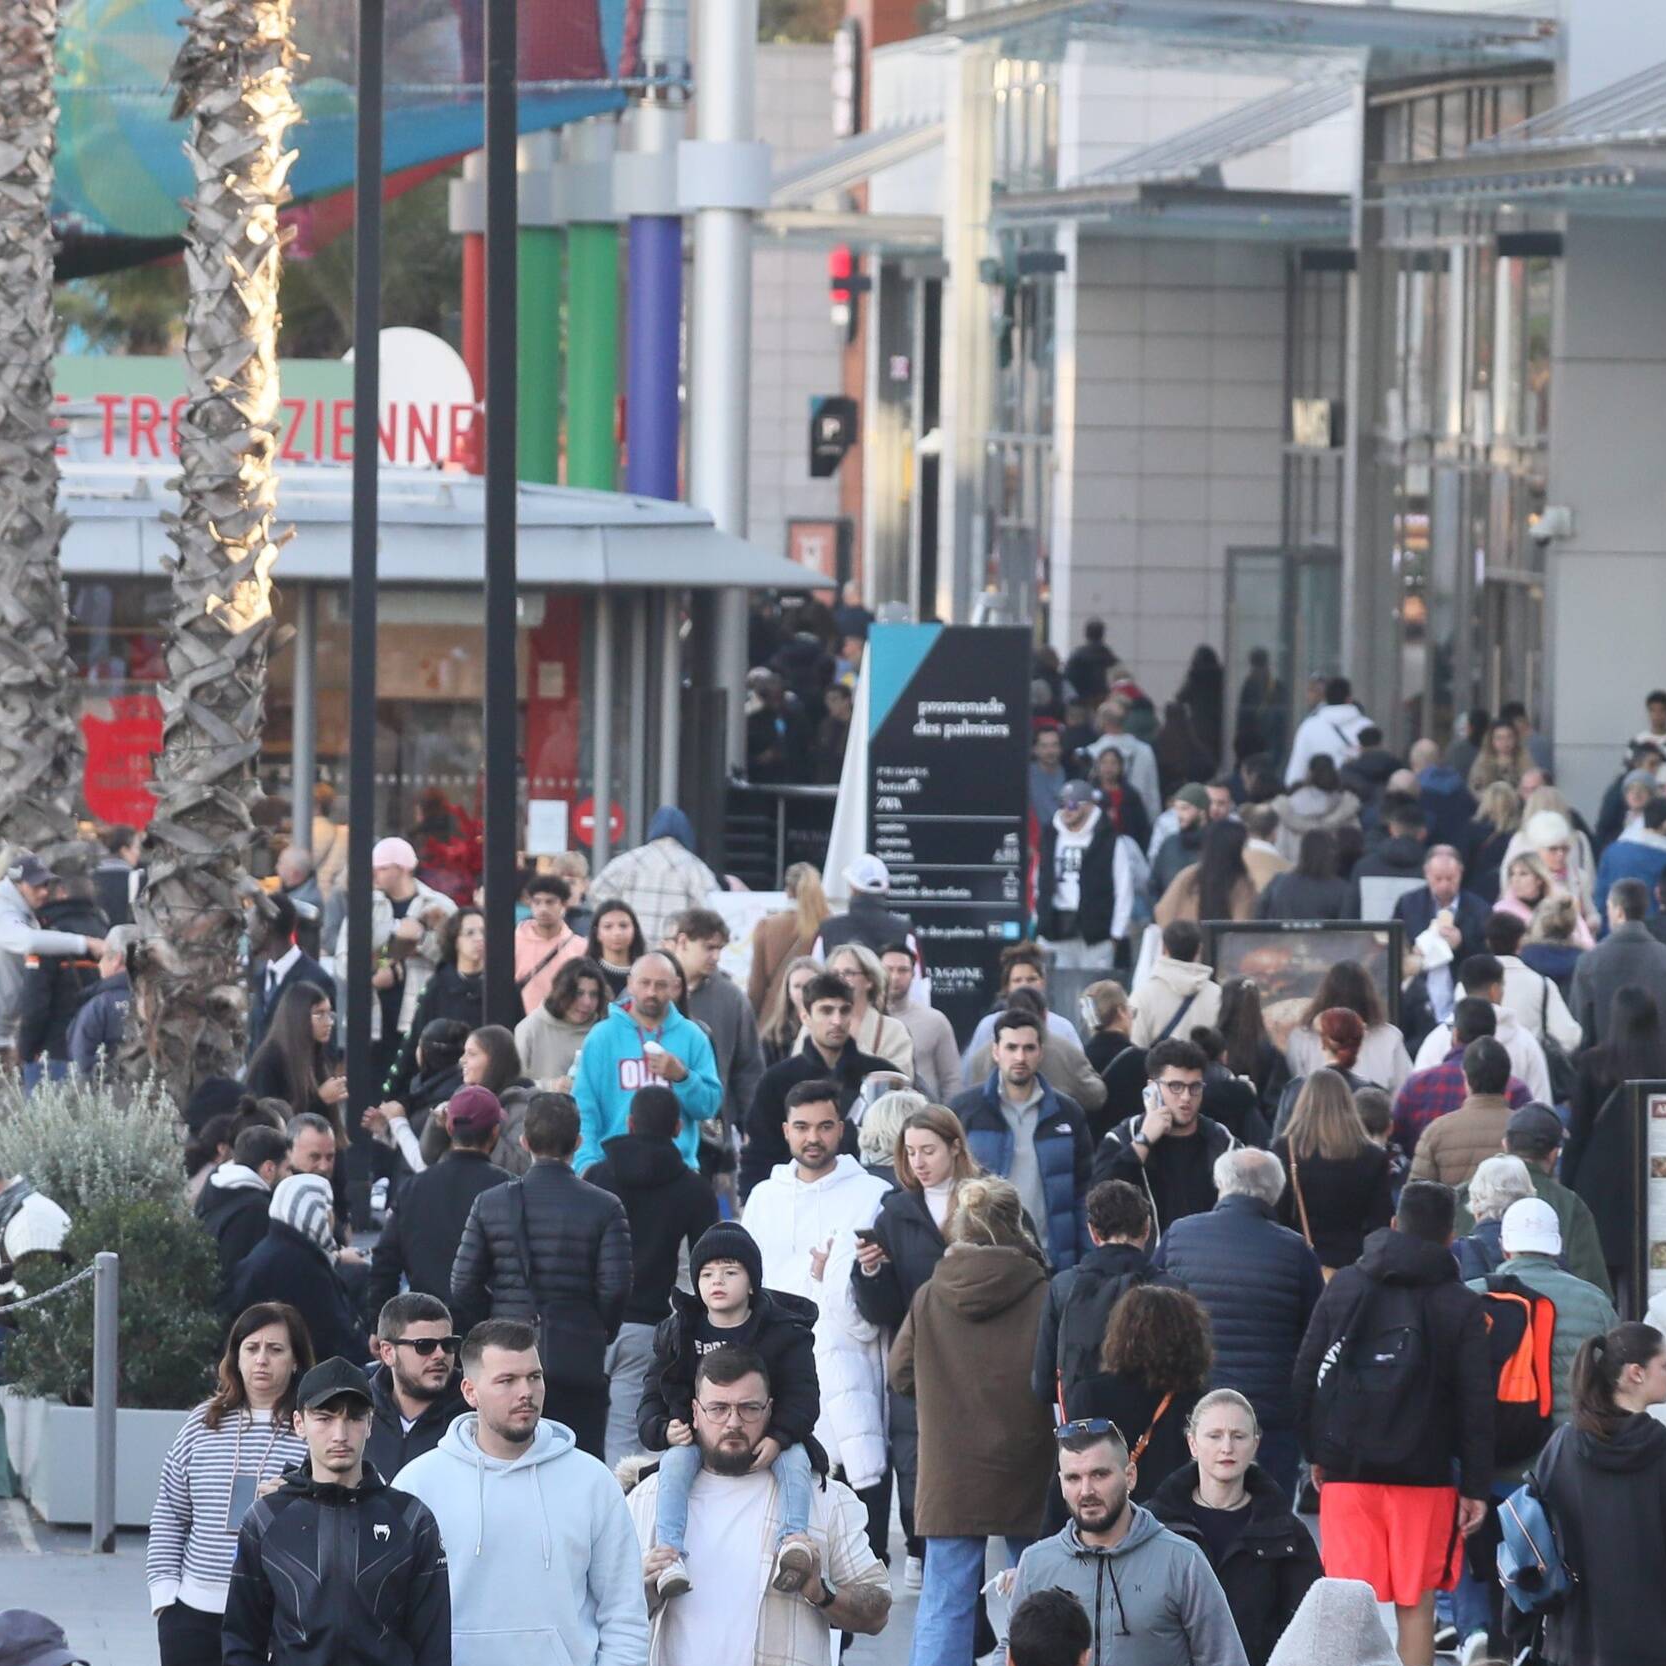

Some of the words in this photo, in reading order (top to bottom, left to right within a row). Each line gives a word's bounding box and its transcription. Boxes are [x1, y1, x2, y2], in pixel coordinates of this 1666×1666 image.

[96, 393, 477, 462] TROZIENNE
[917, 696, 1007, 716] promenade
[912, 718, 941, 736] des
[943, 718, 1010, 741] palmiers
